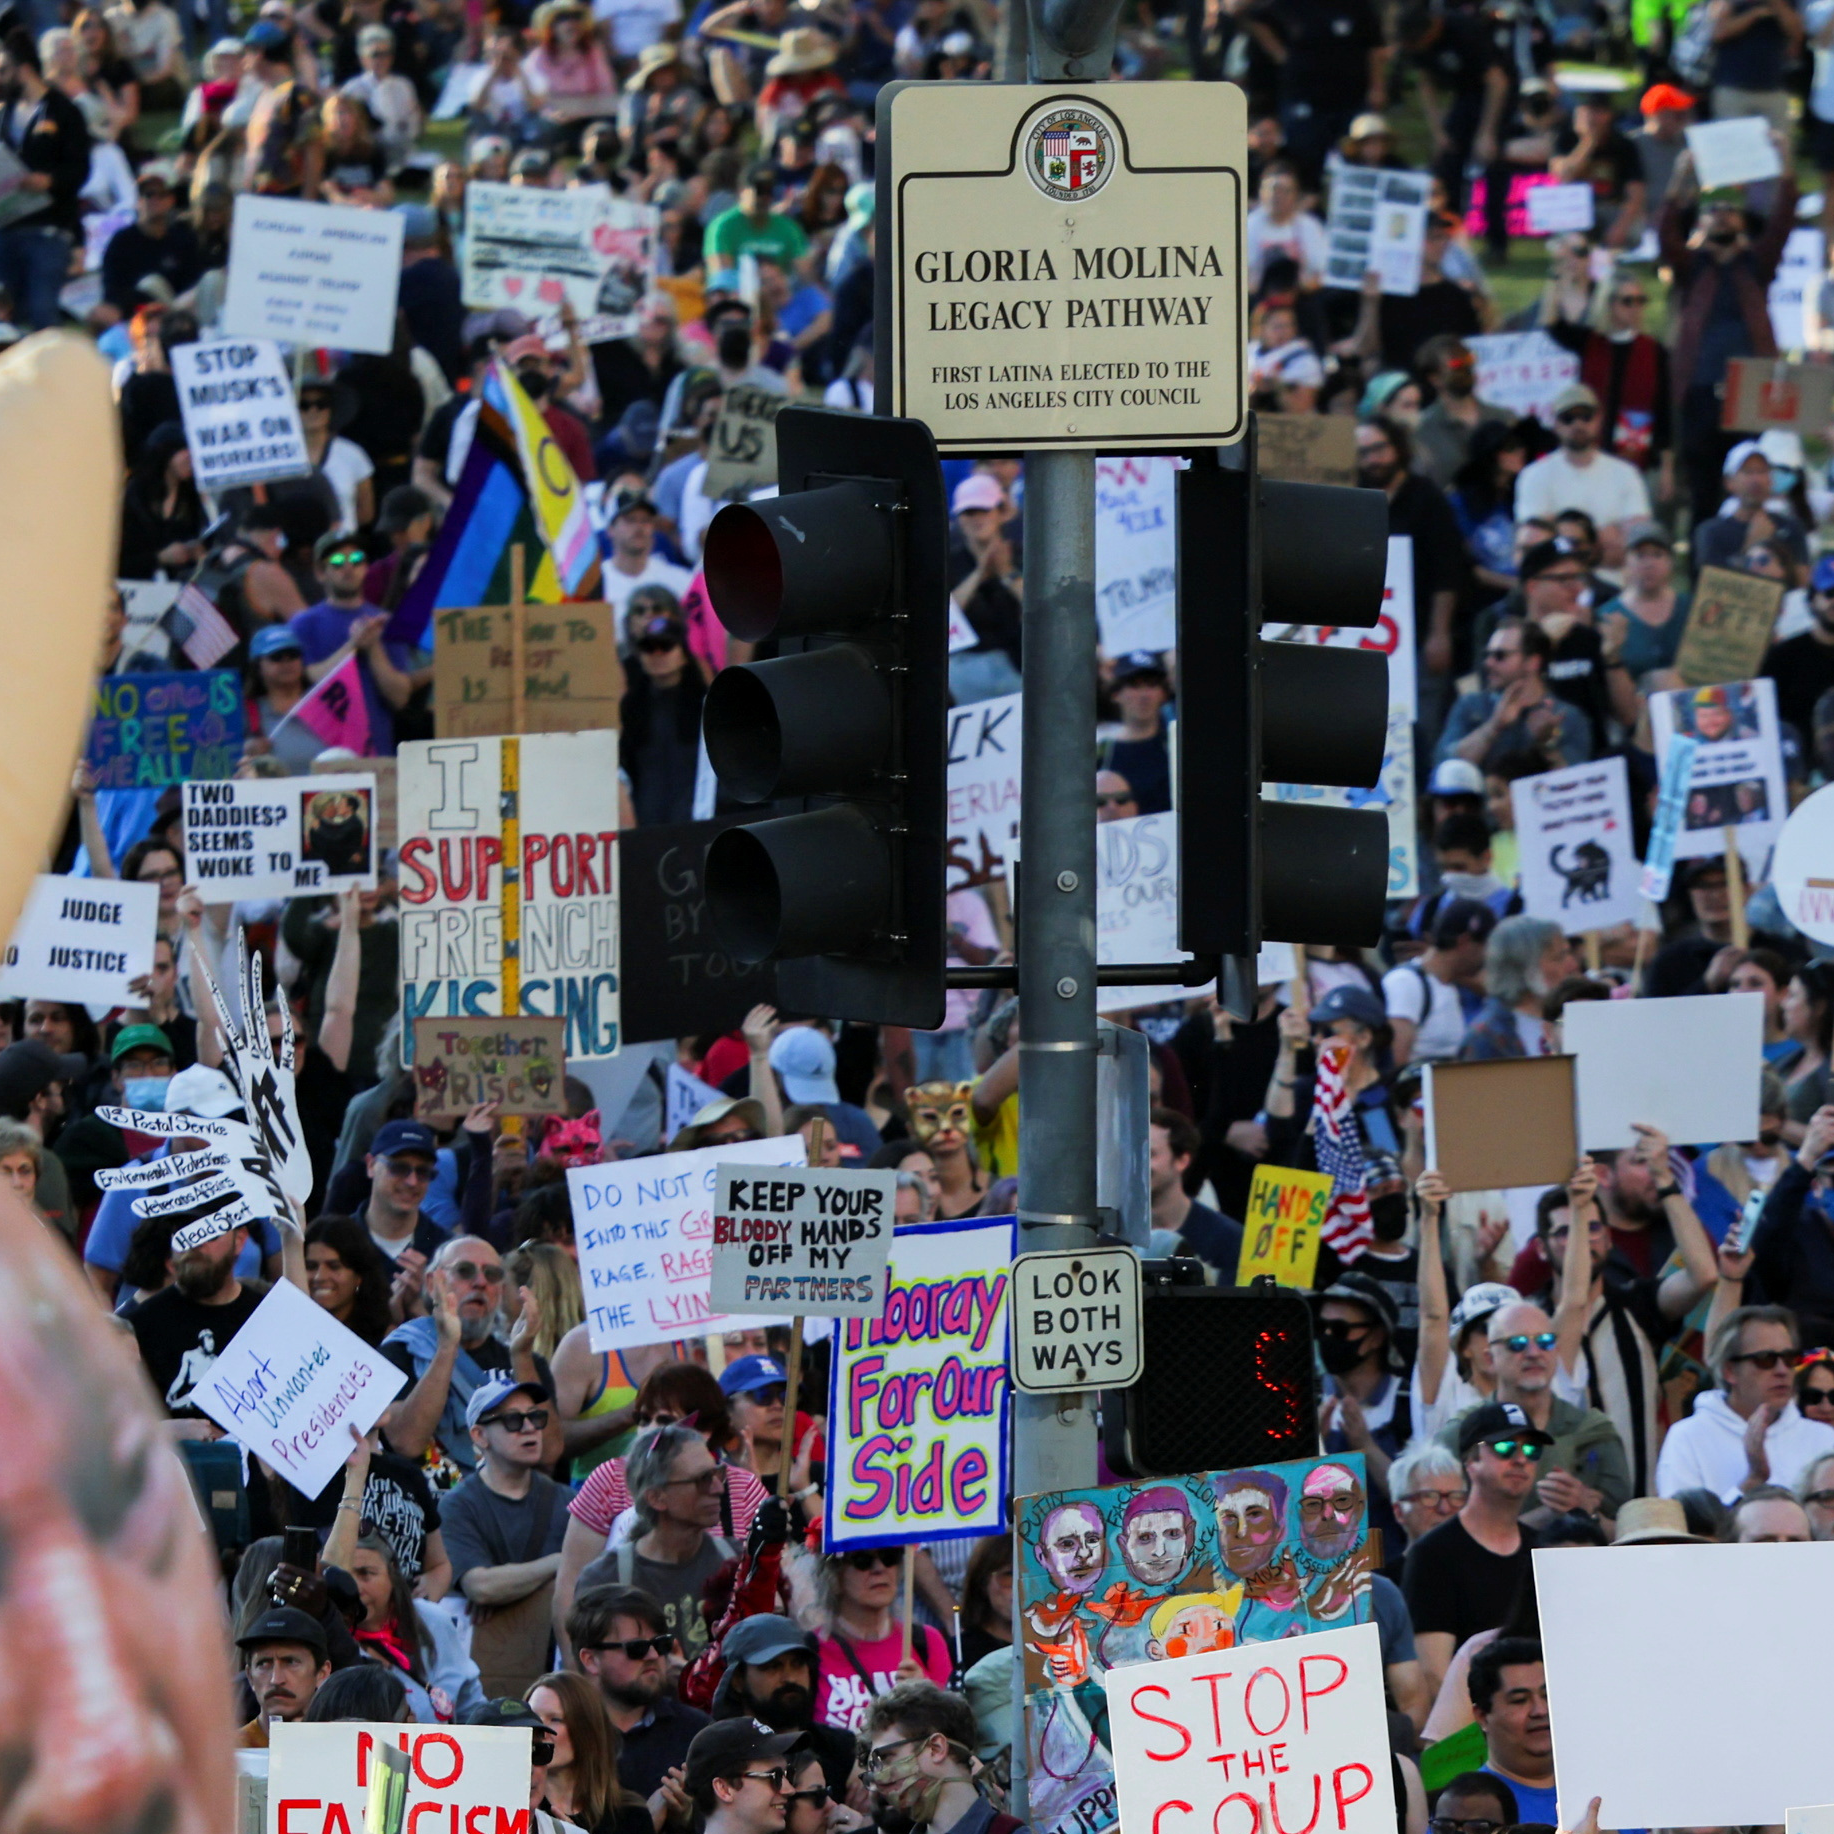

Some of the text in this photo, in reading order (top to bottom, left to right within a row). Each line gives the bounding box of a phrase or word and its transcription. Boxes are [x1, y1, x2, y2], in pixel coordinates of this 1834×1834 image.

[1033, 112, 1107, 140] CITY OF LOS ANGELES
[1045, 186, 1078, 199] FOUNDED
[915, 245, 1222, 285] GLORIA MOLINA
[929, 295, 1212, 332] LEGACY PATHWAY
[195, 344, 257, 374] STOP
[931, 361, 1211, 383] FIRST LATINA ELECTED TO THE
[945, 387, 1200, 411] LOS ANGELES CITY COUNCIL
[197, 421, 250, 447] WAR
[188, 784, 234, 804] TWO
[188, 806, 287, 827] DADDIES?
[188, 831, 253, 852] SEEMS
[198, 853, 322, 887] WOKE TO ME
[399, 830, 618, 905] SUPPORT
[60, 898, 123, 924] JUDGE
[399, 904, 617, 980] FRENCH
[48, 946, 128, 973] JUSTICE
[132, 1112, 174, 1132] Postal
[175, 1116, 228, 1136] Service
[137, 1176, 235, 1216] Veterans Affairs
[728, 1179, 883, 1216] KEEP YOUR
[1249, 1182, 1326, 1227] HANDS
[175, 1201, 253, 1250] Head Start
[714, 1216, 881, 1246] BLOODY HANDS
[748, 1243, 852, 1270] OFF MY
[1250, 1221, 1307, 1264] OFF
[745, 1274, 873, 1302] PARTNERS
[1032, 1269, 1122, 1301] LOOK
[1034, 1304, 1122, 1335] BOTH
[1032, 1340, 1123, 1371] WAYS
[213, 1350, 279, 1424] Abort
[257, 1341, 331, 1430] Unwanted
[271, 1359, 373, 1470] Presidencies
[845, 1433, 988, 1521] Side
[1128, 1652, 1351, 1763] STOP
[1207, 1741, 1290, 1783] THE
